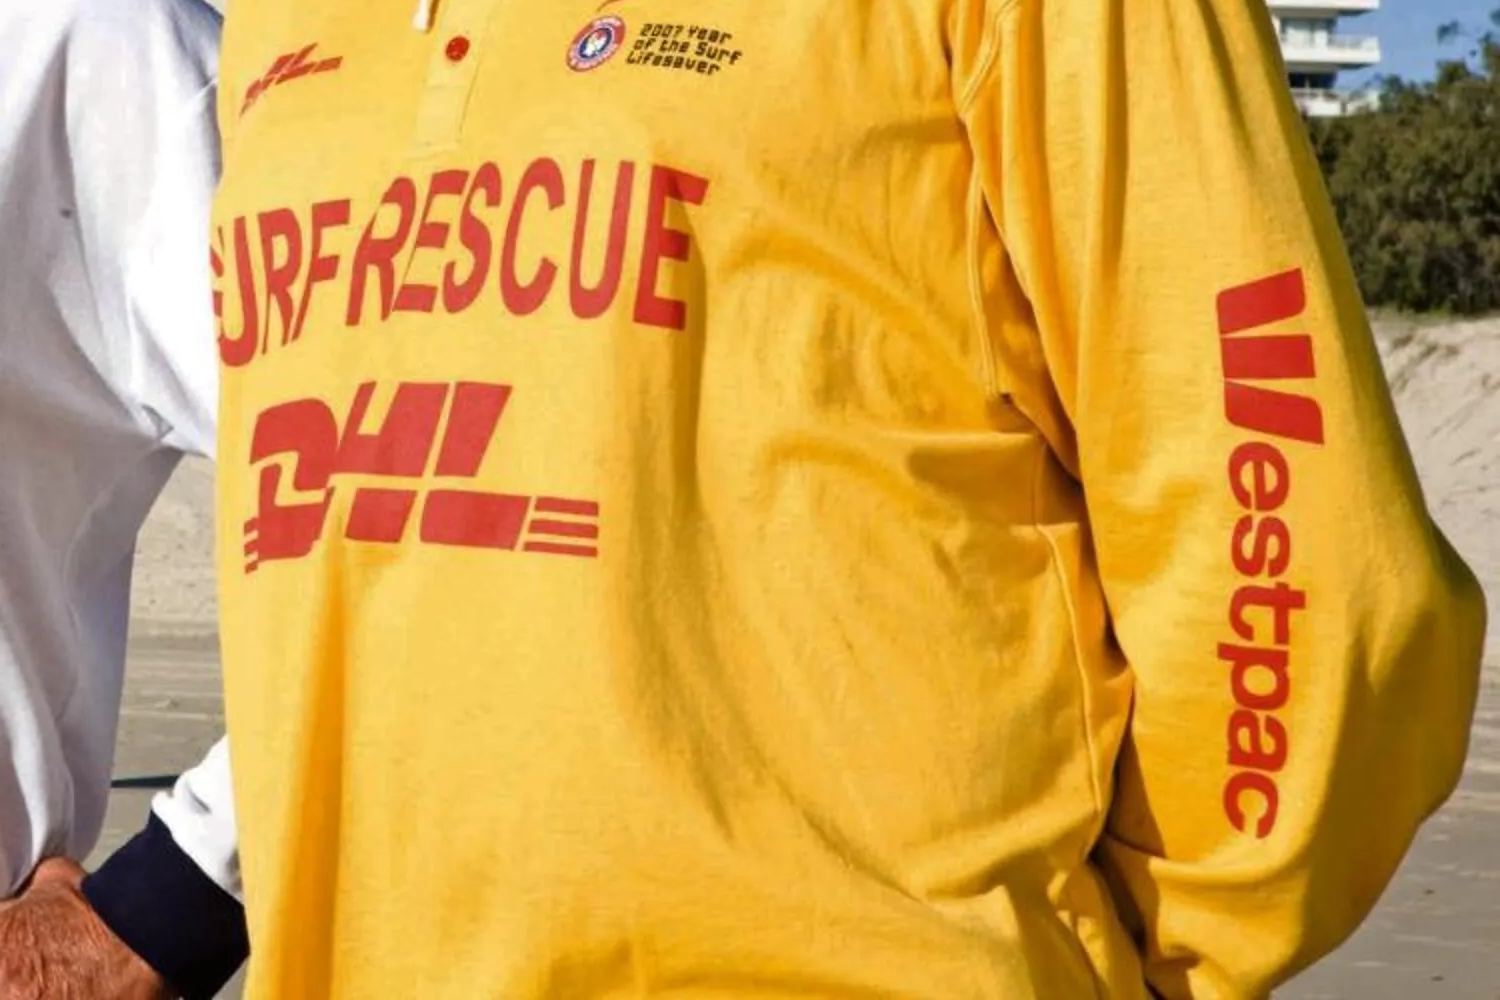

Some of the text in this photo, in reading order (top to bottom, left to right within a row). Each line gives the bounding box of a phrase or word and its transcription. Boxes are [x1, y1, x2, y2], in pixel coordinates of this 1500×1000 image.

[626, 50, 721, 75] Lifesaver
[633, 37, 743, 66] of the Surf
[640, 23, 733, 44] 2007 Year
[209, 157, 709, 368] URF RESCUE
[250, 380, 534, 566] DHL
[1216, 267, 1325, 840] Westpac
